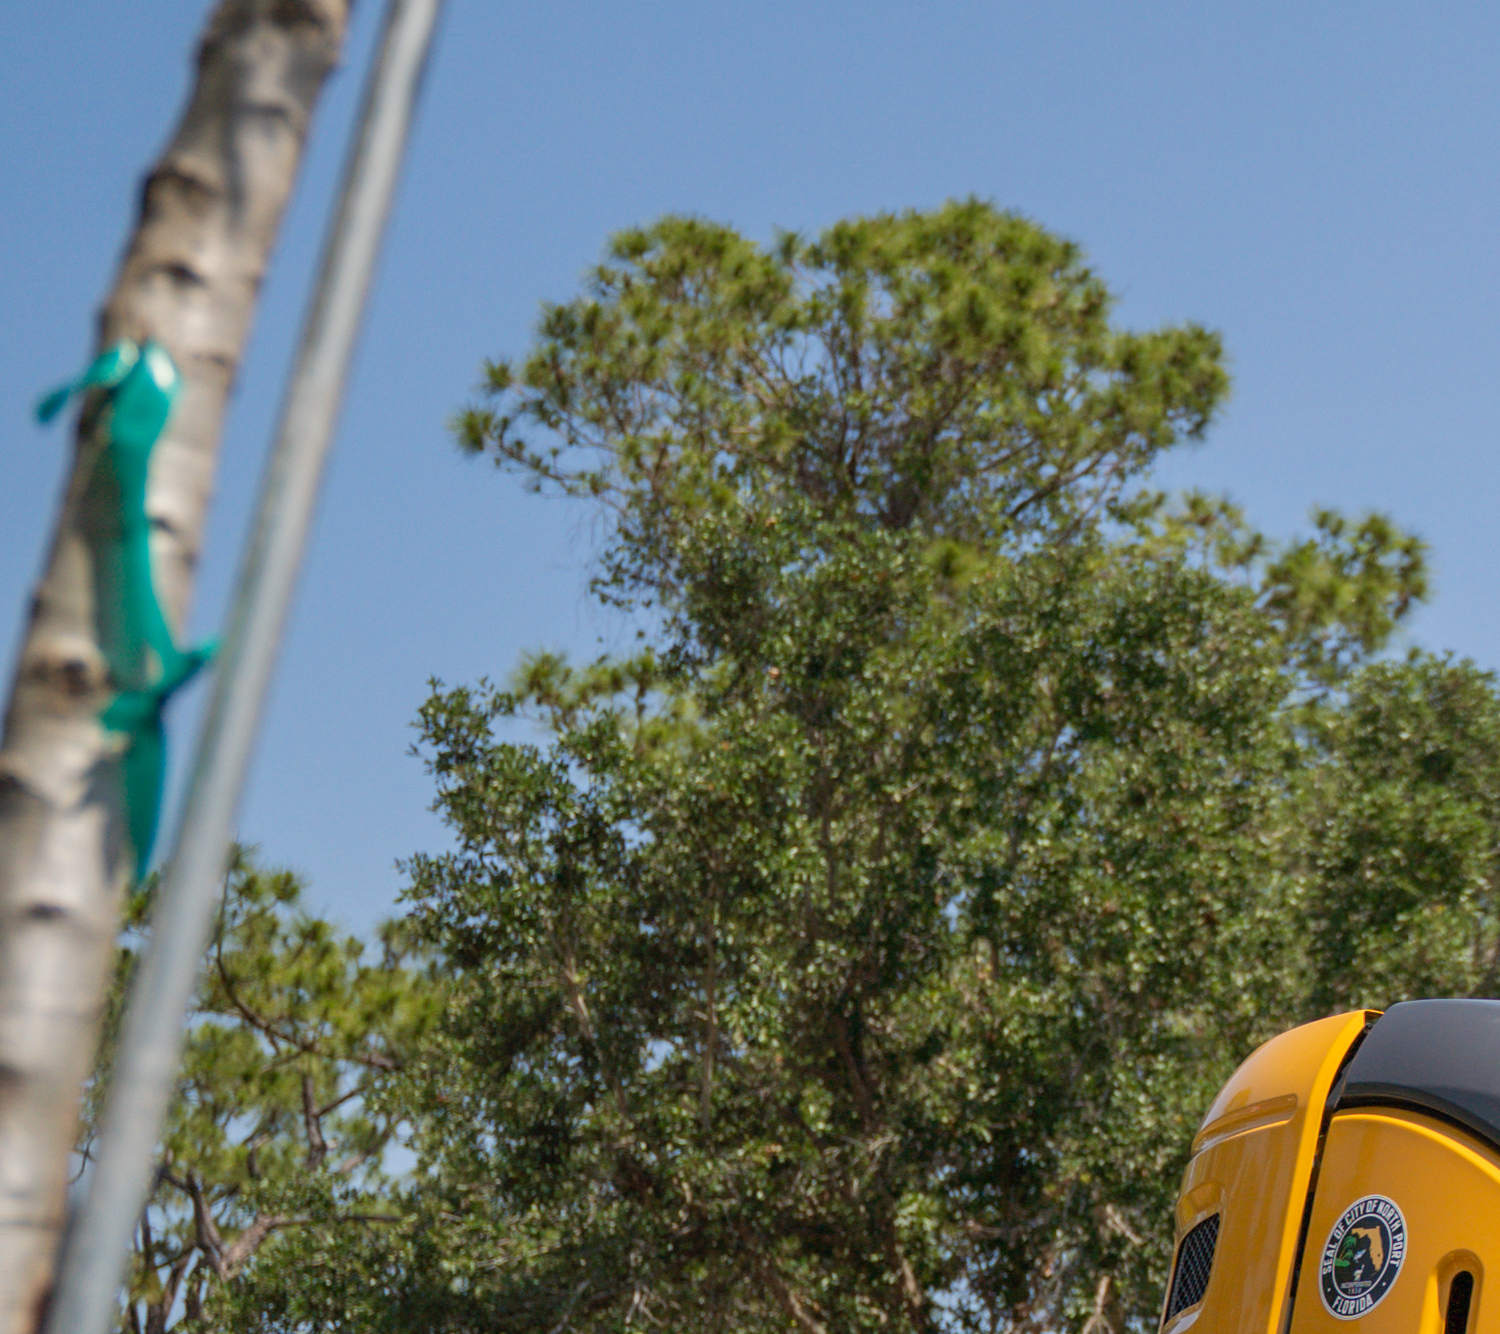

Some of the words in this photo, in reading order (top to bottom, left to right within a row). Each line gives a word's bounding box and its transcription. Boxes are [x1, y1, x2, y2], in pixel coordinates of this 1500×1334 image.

[1322, 1242, 1338, 1275] SEAL
[1333, 1222, 1346, 1240] OF
[1344, 1204, 1365, 1227] CITY
[1366, 1199, 1379, 1213] OF
[1377, 1200, 1402, 1233] NORTH
[1390, 1232, 1404, 1268] PORT
[1331, 1293, 1374, 1315] FLORIDA
